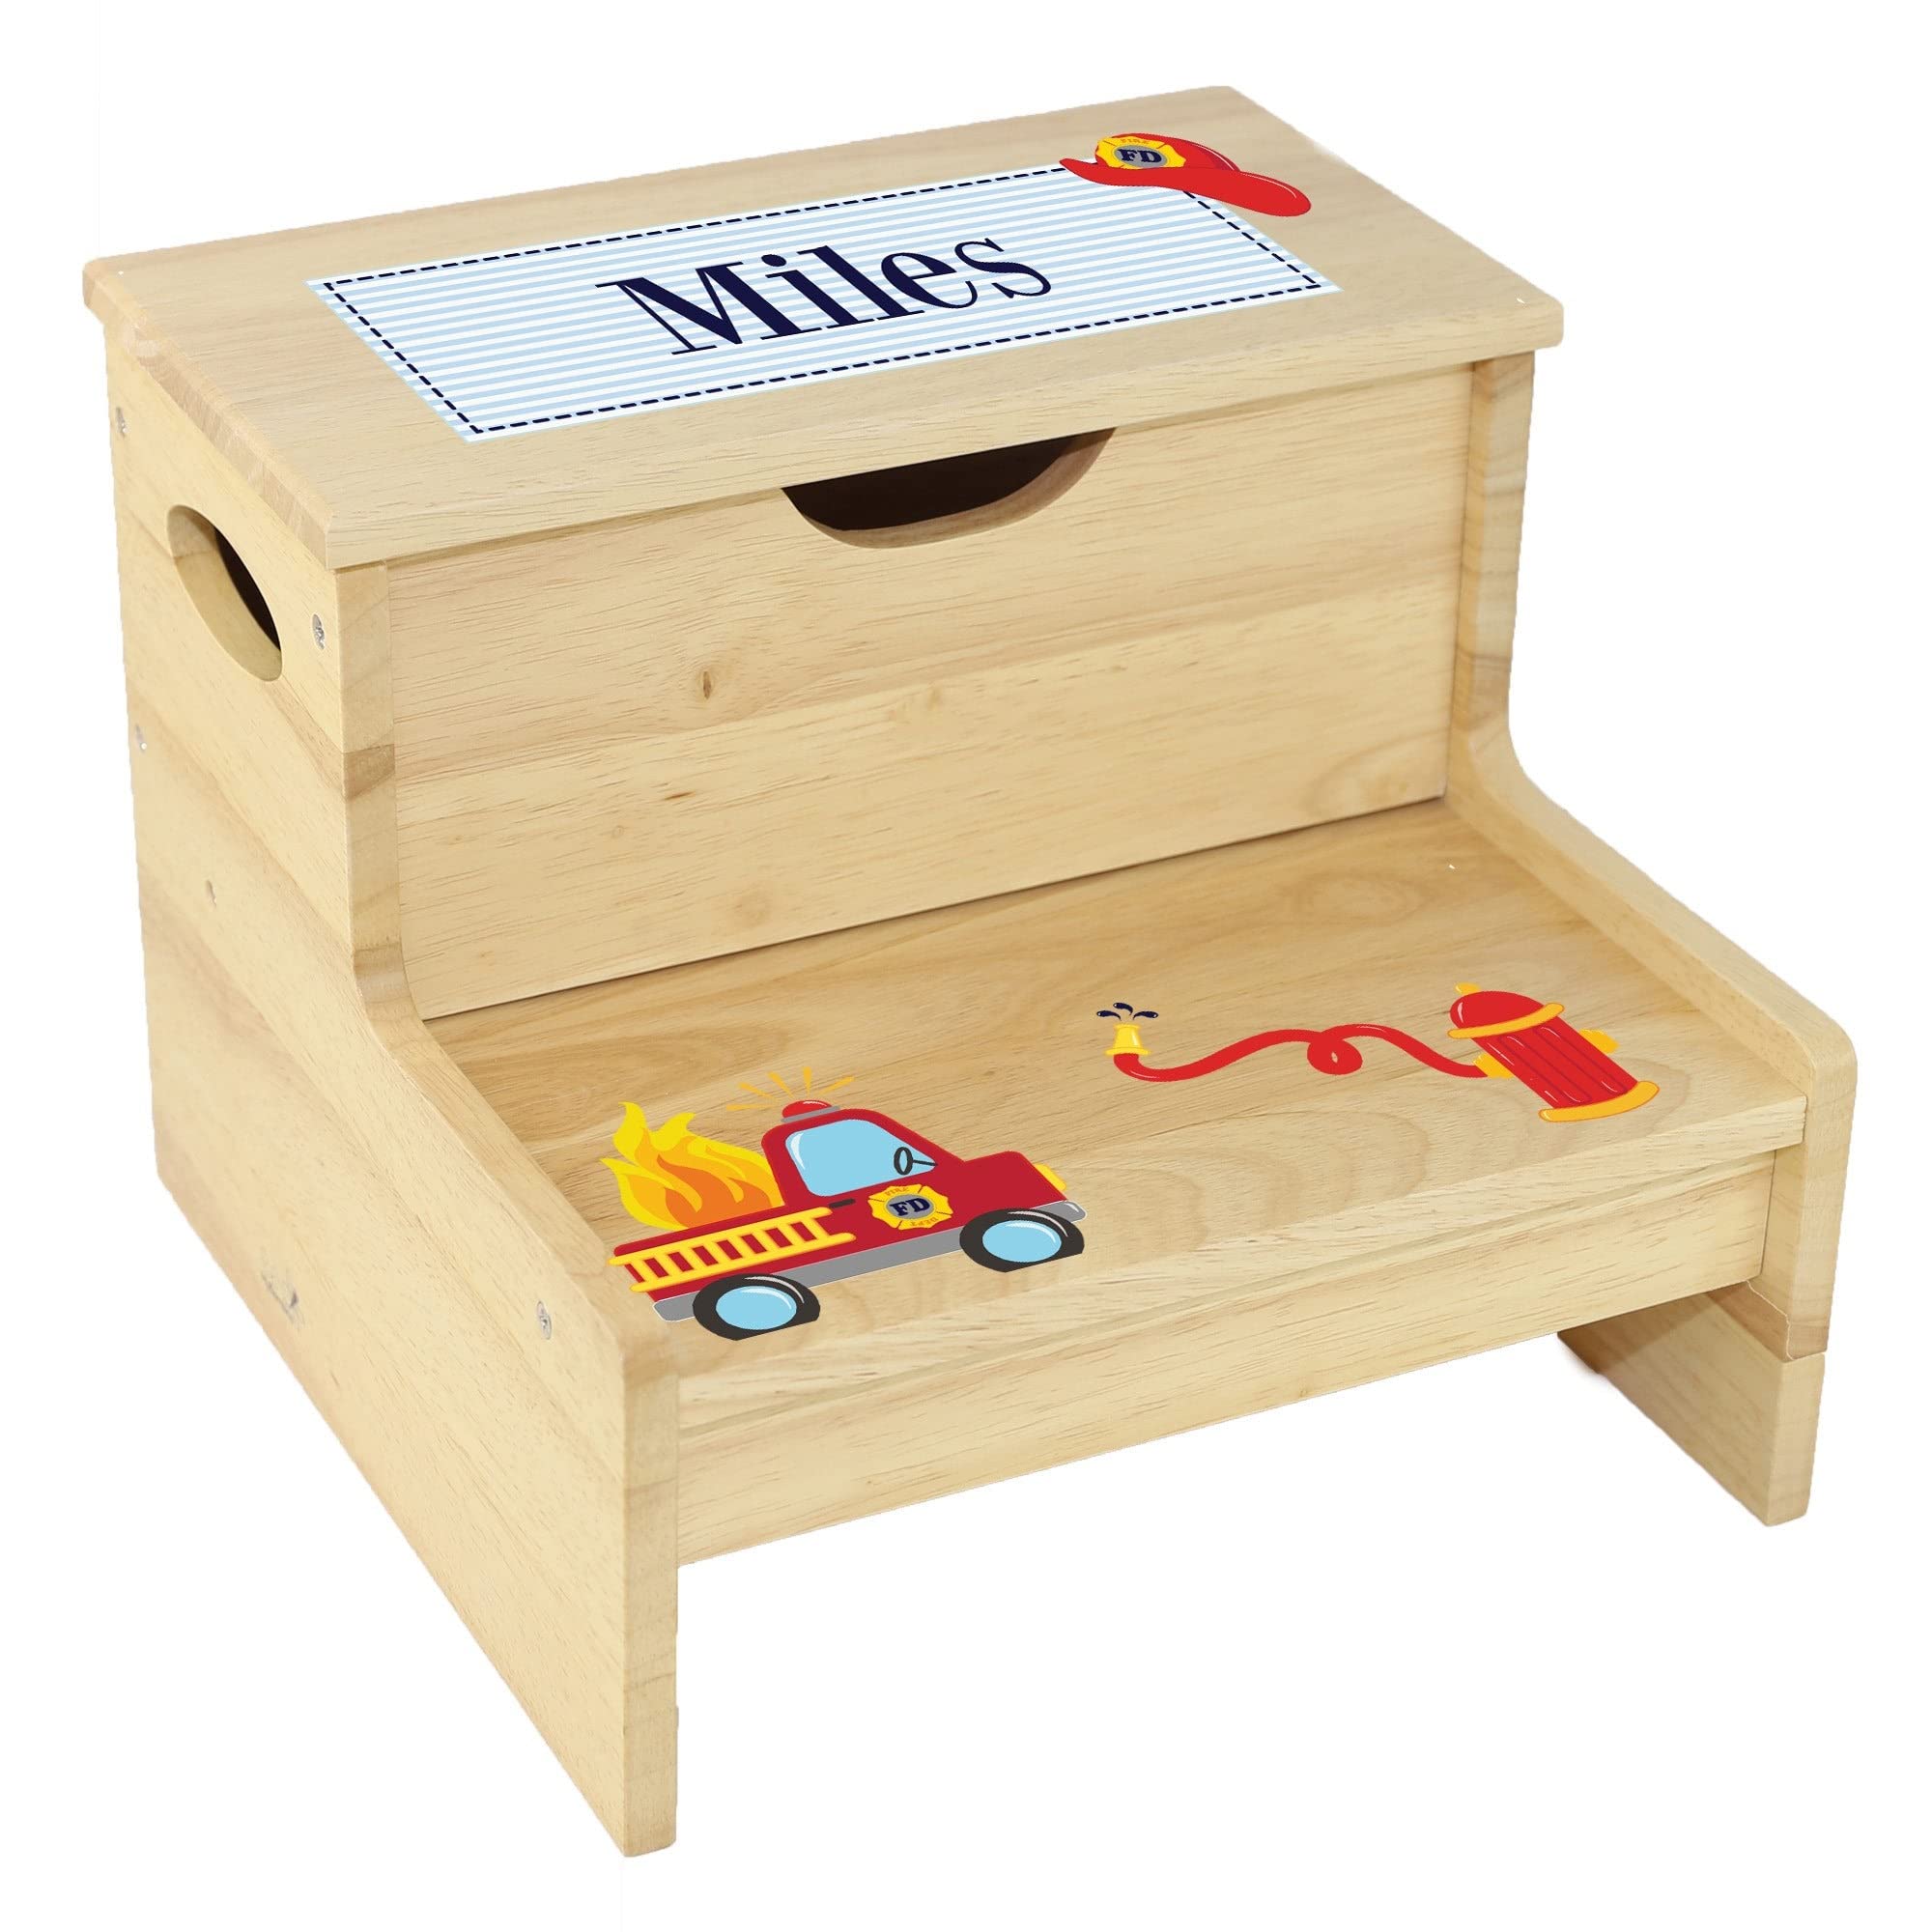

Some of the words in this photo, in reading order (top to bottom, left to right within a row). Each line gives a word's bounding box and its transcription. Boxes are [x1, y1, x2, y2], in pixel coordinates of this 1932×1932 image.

[1117, 149, 1162, 163] FD
[594, 237, 1052, 355] Miles
[889, 1197, 930, 1216] FD
